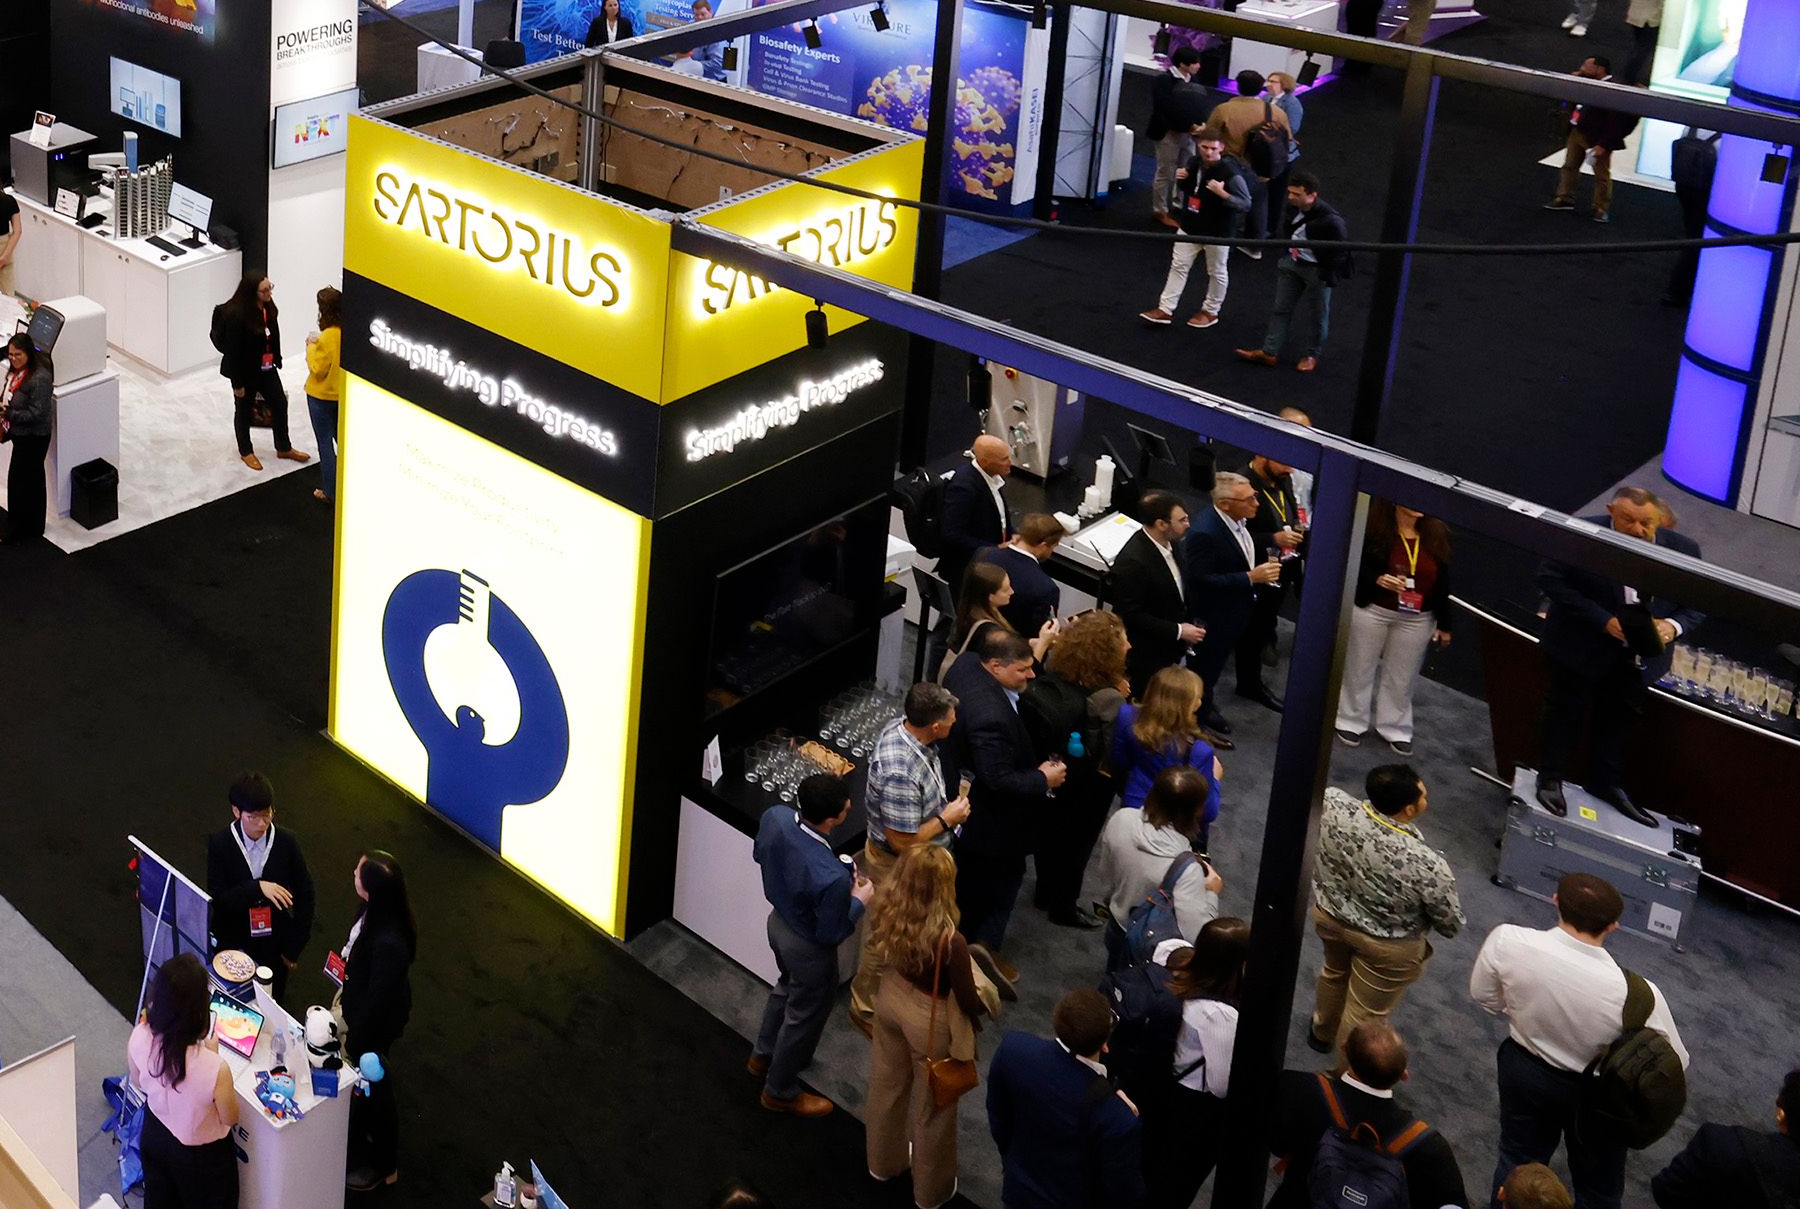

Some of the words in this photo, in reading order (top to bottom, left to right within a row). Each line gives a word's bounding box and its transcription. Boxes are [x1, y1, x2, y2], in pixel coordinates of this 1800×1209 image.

[136, 7, 169, 24] antibodies
[170, 17, 204, 34] unleashed
[277, 19, 353, 51] POWERING
[532, 28, 553, 44] Test
[276, 34, 353, 61] BREAKTHROUGHS
[759, 34, 803, 56] Biosafety
[804, 46, 841, 65] Experts
[763, 67, 774, 76] Cell
[810, 79, 830, 91] Testing
[373, 171, 623, 308] SARTORIUS
[702, 199, 898, 315] SATORIUS
[369, 318, 501, 408] Simplifying
[501, 377, 619, 459] Progress
[686, 392, 801, 463] Simplifying
[799, 357, 886, 413] Progress
